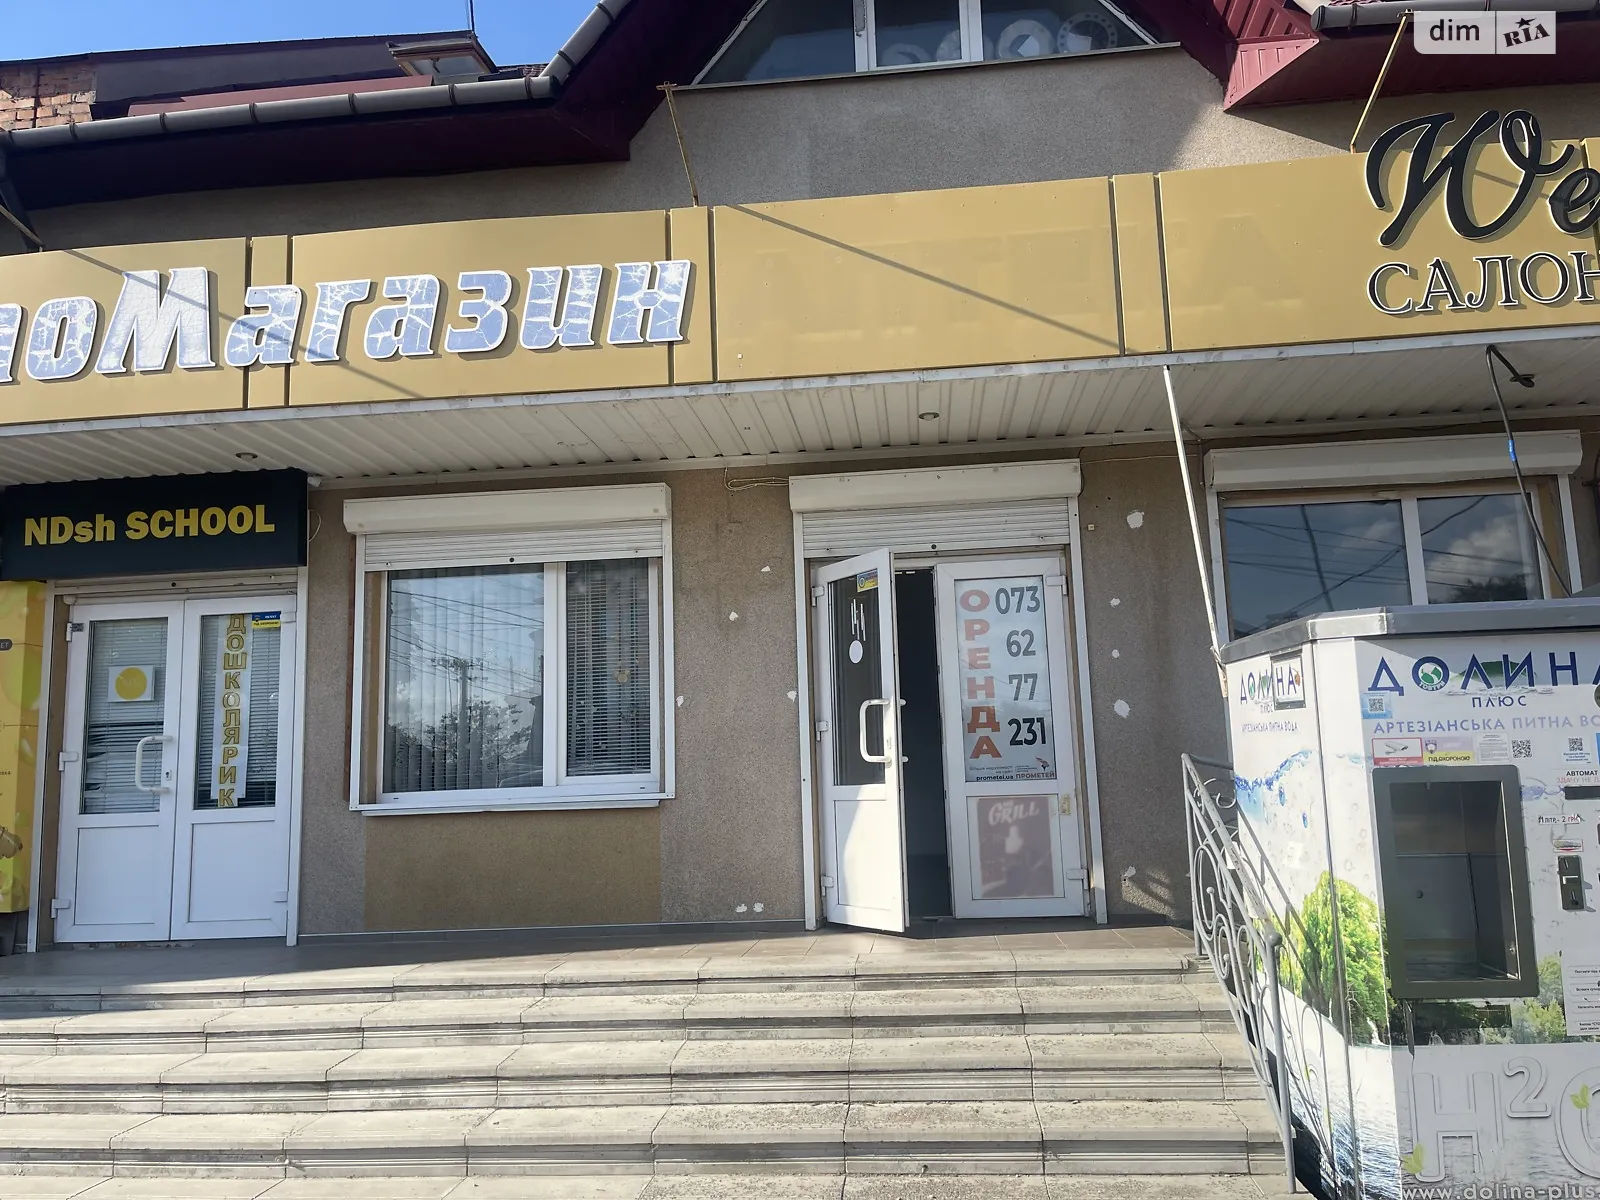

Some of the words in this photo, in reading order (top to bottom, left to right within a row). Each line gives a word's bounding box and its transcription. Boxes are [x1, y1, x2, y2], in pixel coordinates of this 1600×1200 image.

[1366, 251, 1600, 314] САЛОН
[24, 514, 116, 546] NDsh
[125, 505, 275, 540] SCHOOL
[995, 586, 1041, 615] 073
[1006, 629, 1036, 658] 62
[960, 589, 1003, 759] ОРЕНДА
[1009, 673, 1038, 701] 77
[1368, 651, 1600, 696] ДОЛИН
[218, 614, 247, 807] ДОШКОЛЯРИК
[1472, 695, 1527, 708] ПЛЮС
[1007, 718, 1046, 746] 231
[1374, 716, 1505, 733] АРТЕЗІАНСЬКА
[1512, 715, 1573, 729] ПИТНА
[1016, 771, 1055, 779] ПРОМЕТЕЙ
